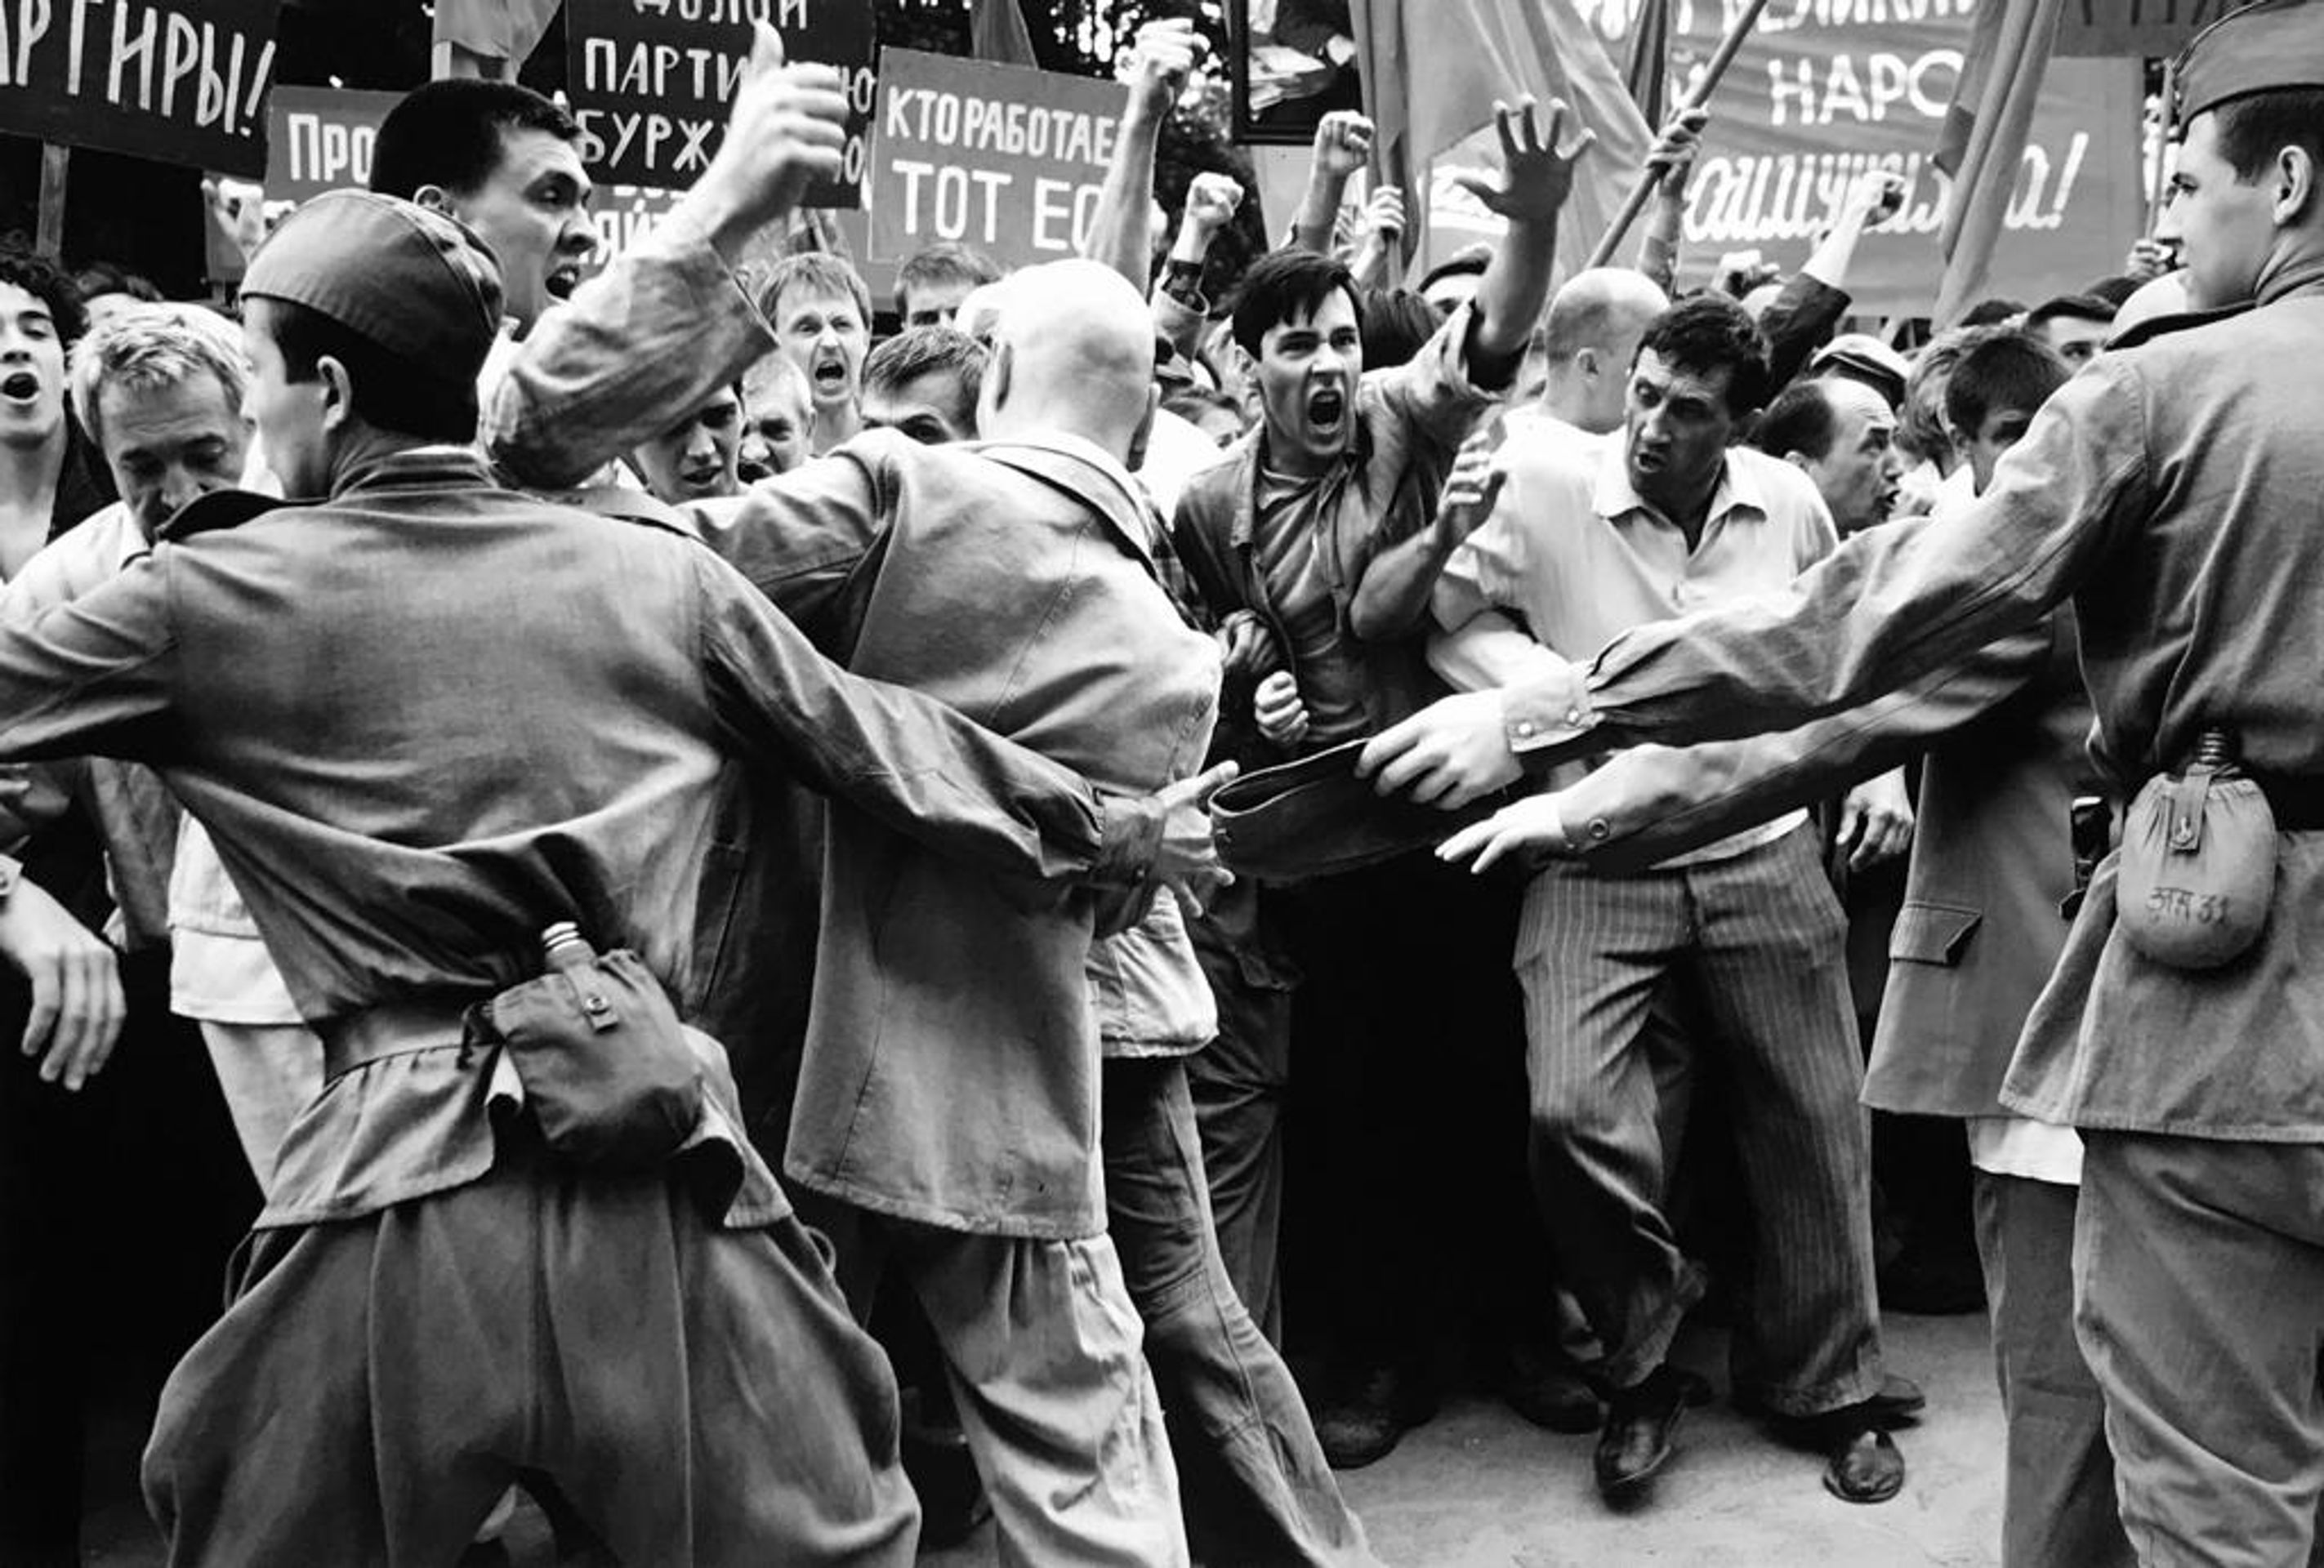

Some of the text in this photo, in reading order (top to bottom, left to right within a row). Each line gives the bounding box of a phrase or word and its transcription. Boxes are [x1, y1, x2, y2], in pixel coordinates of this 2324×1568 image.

[0, 0, 276, 137] РТИРЫ!
[585, 38, 874, 114] ПАРТИЮ
[887, 85, 1121, 168] КТО РАБОТАЕ
[892, 159, 1013, 244] ТОТ
